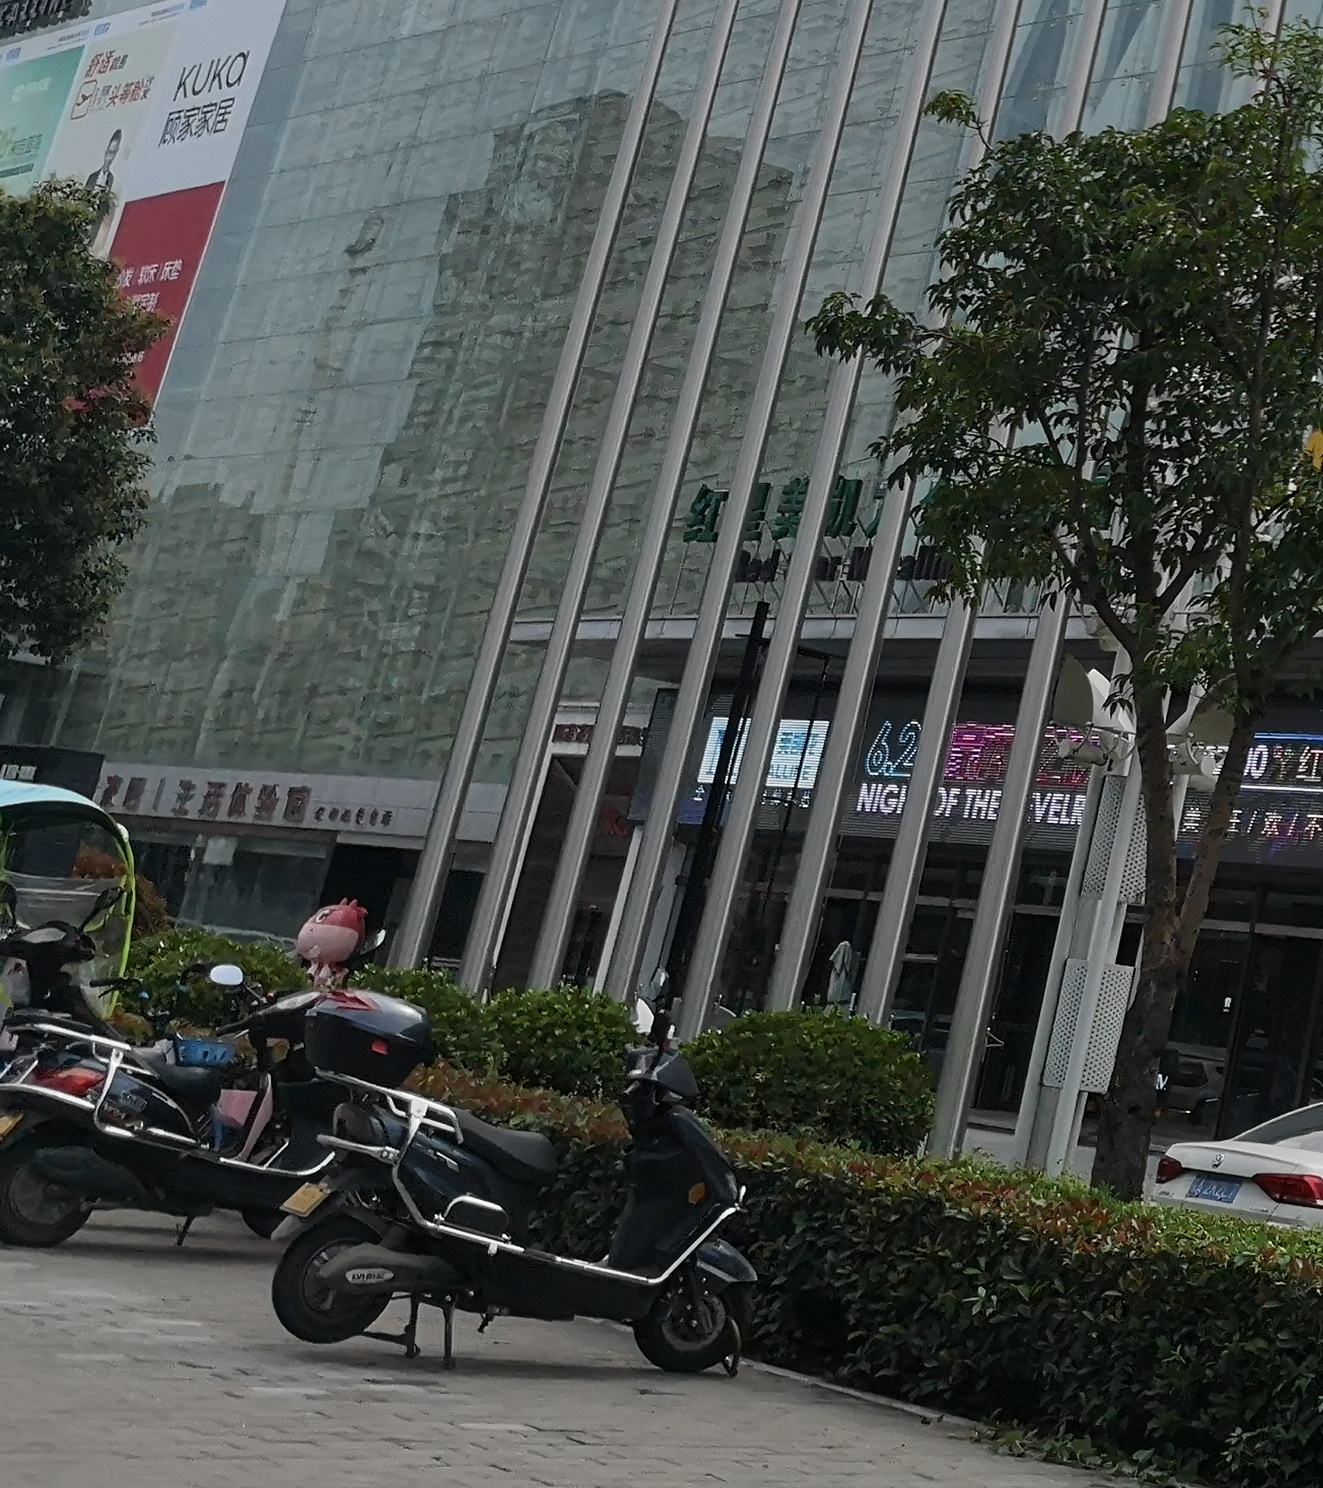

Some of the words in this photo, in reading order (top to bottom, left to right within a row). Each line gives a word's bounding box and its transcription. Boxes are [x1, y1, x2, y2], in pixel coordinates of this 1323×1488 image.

[157, 97, 236, 148] 顾家家居
[856, 783, 907, 815] NIG
[962, 788, 1002, 821] THE
